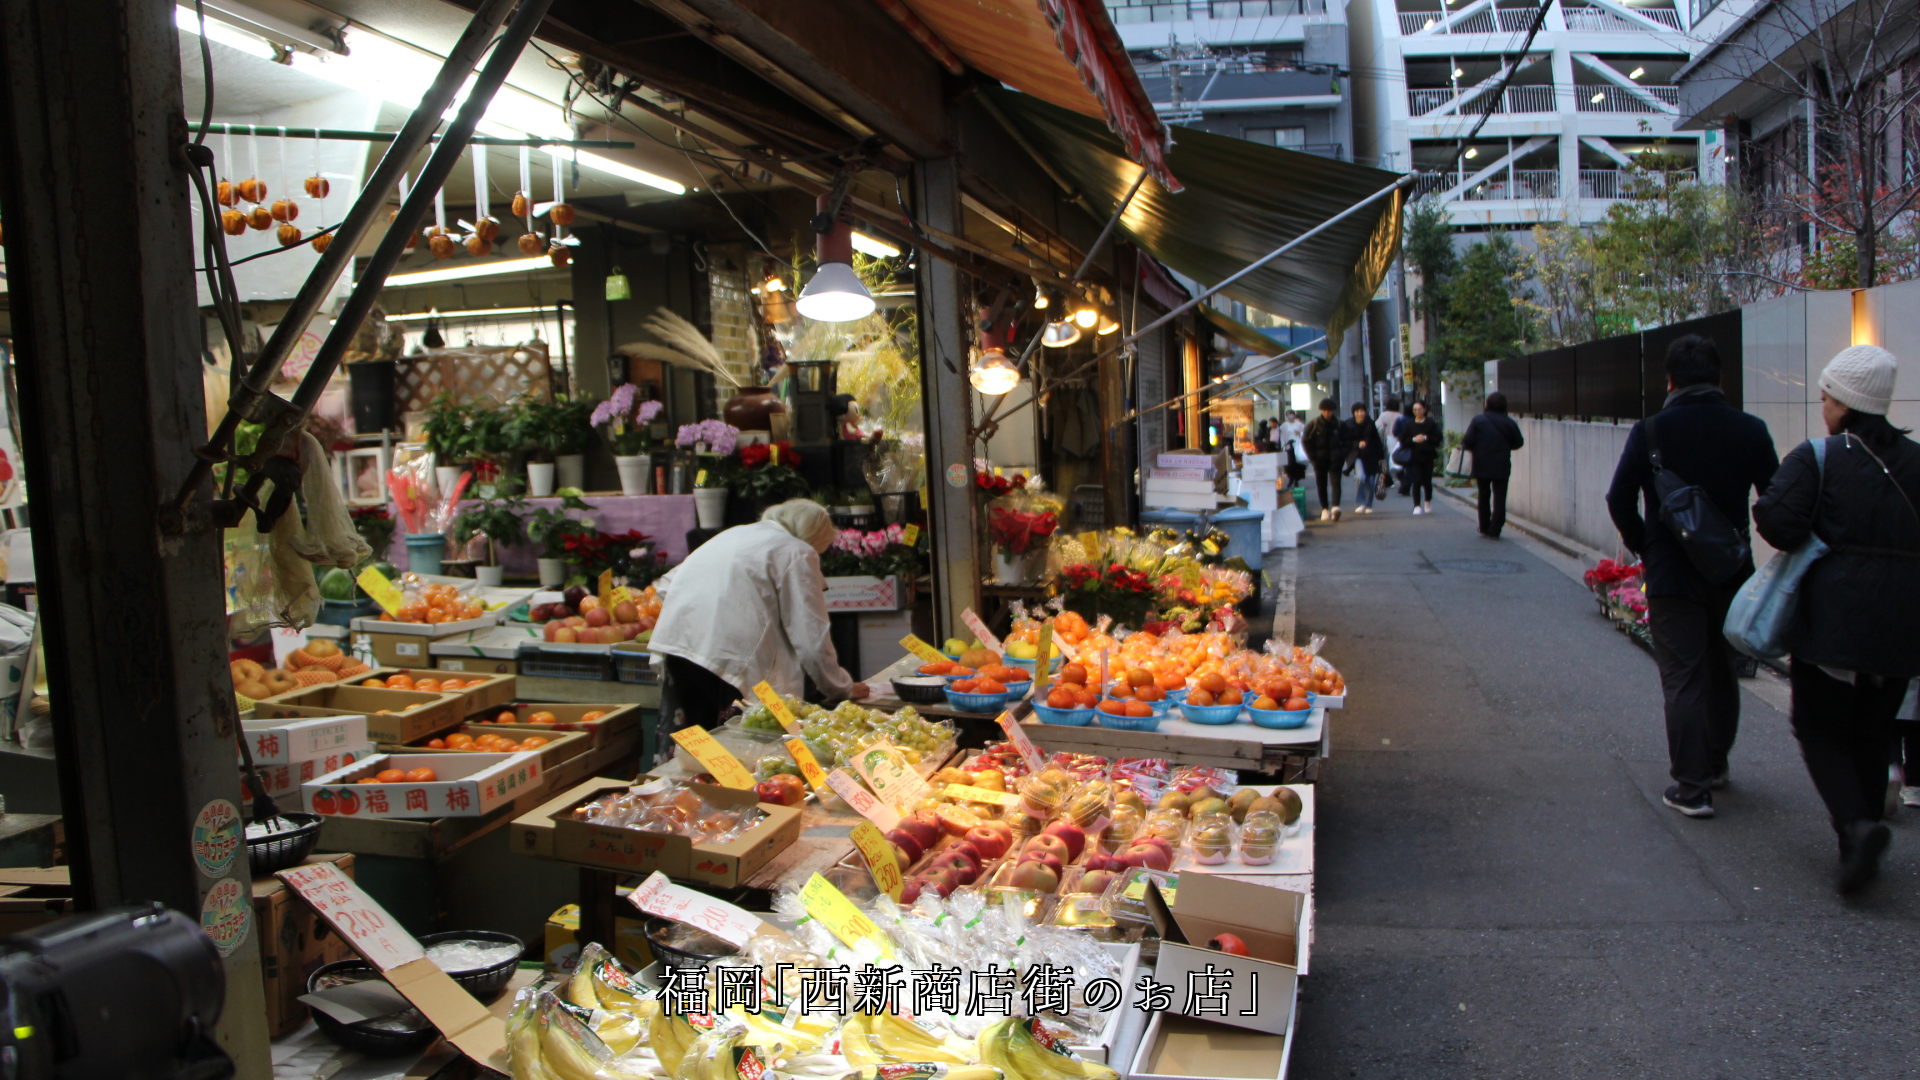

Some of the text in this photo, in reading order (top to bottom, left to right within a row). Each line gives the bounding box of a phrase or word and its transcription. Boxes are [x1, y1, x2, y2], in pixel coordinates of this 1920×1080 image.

[256, 733, 280, 759] 柿
[274, 754, 338, 792] 福岡柿
[706, 754, 738, 778] 550
[364, 786, 471, 814] 福岡柿
[850, 790, 875, 813] 350
[875, 862, 898, 894] 350
[335, 908, 385, 940] 200
[691, 905, 730, 932] 200
[840, 914, 872, 938] 300
